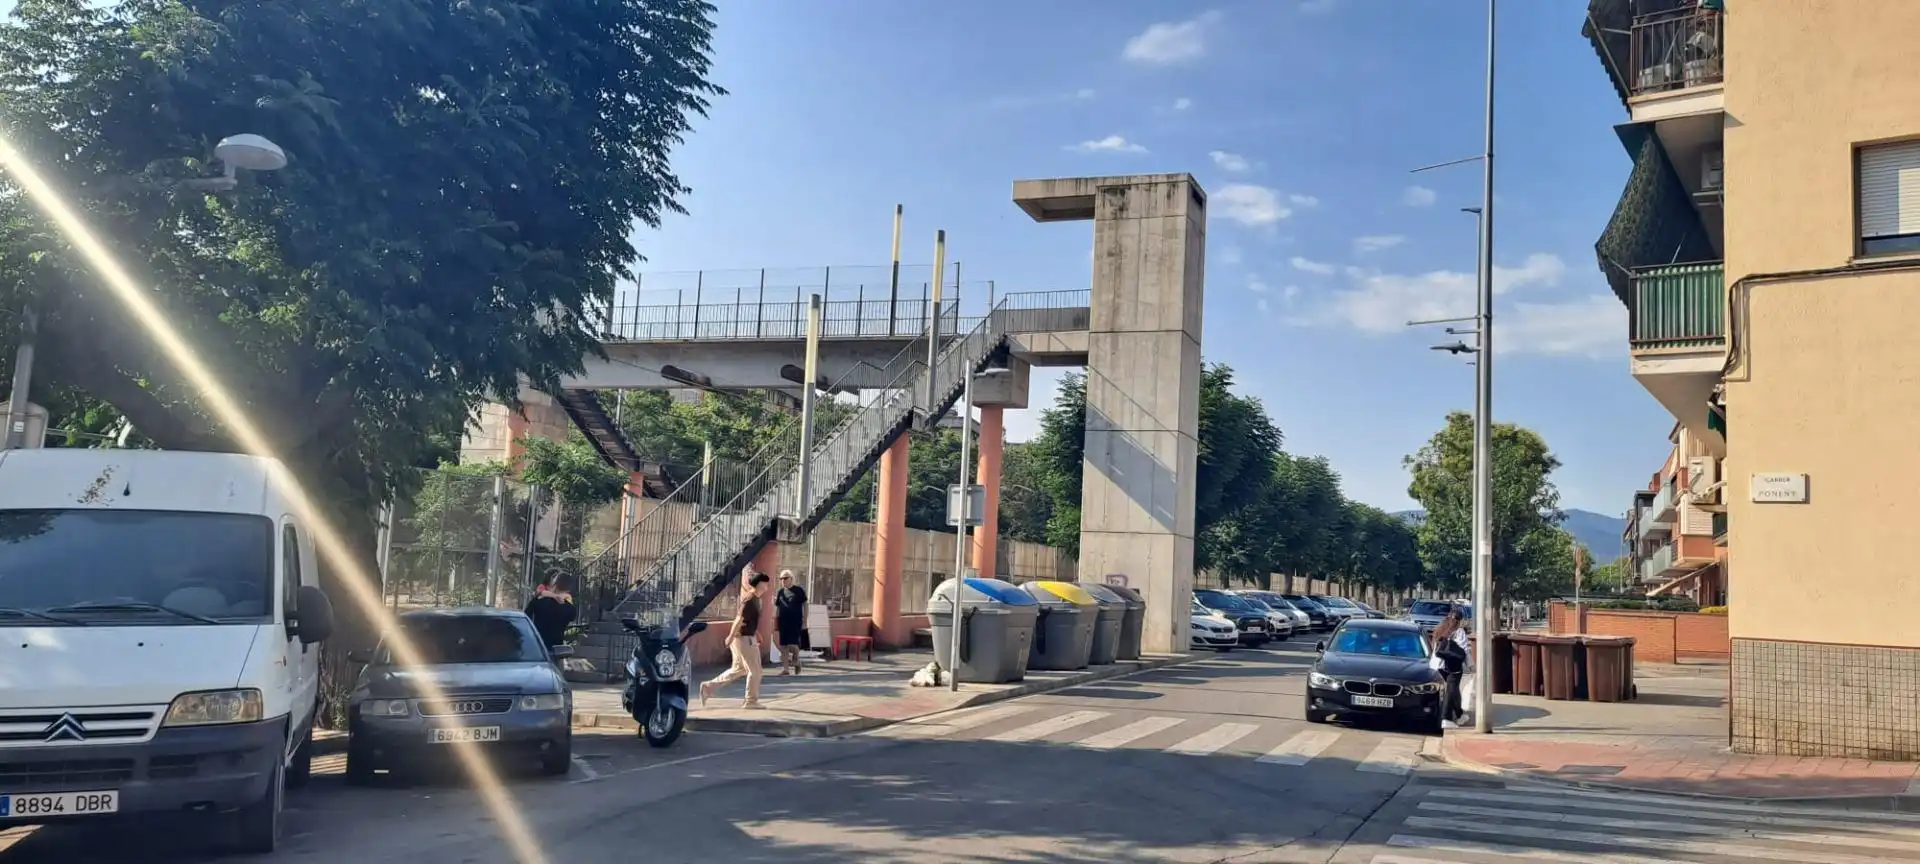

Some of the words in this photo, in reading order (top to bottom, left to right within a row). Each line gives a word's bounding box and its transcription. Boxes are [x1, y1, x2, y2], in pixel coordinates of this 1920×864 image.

[1758, 490, 1796, 498] PONENT
[15, 797, 64, 813] 8894
[76, 794, 112, 811] DBR
